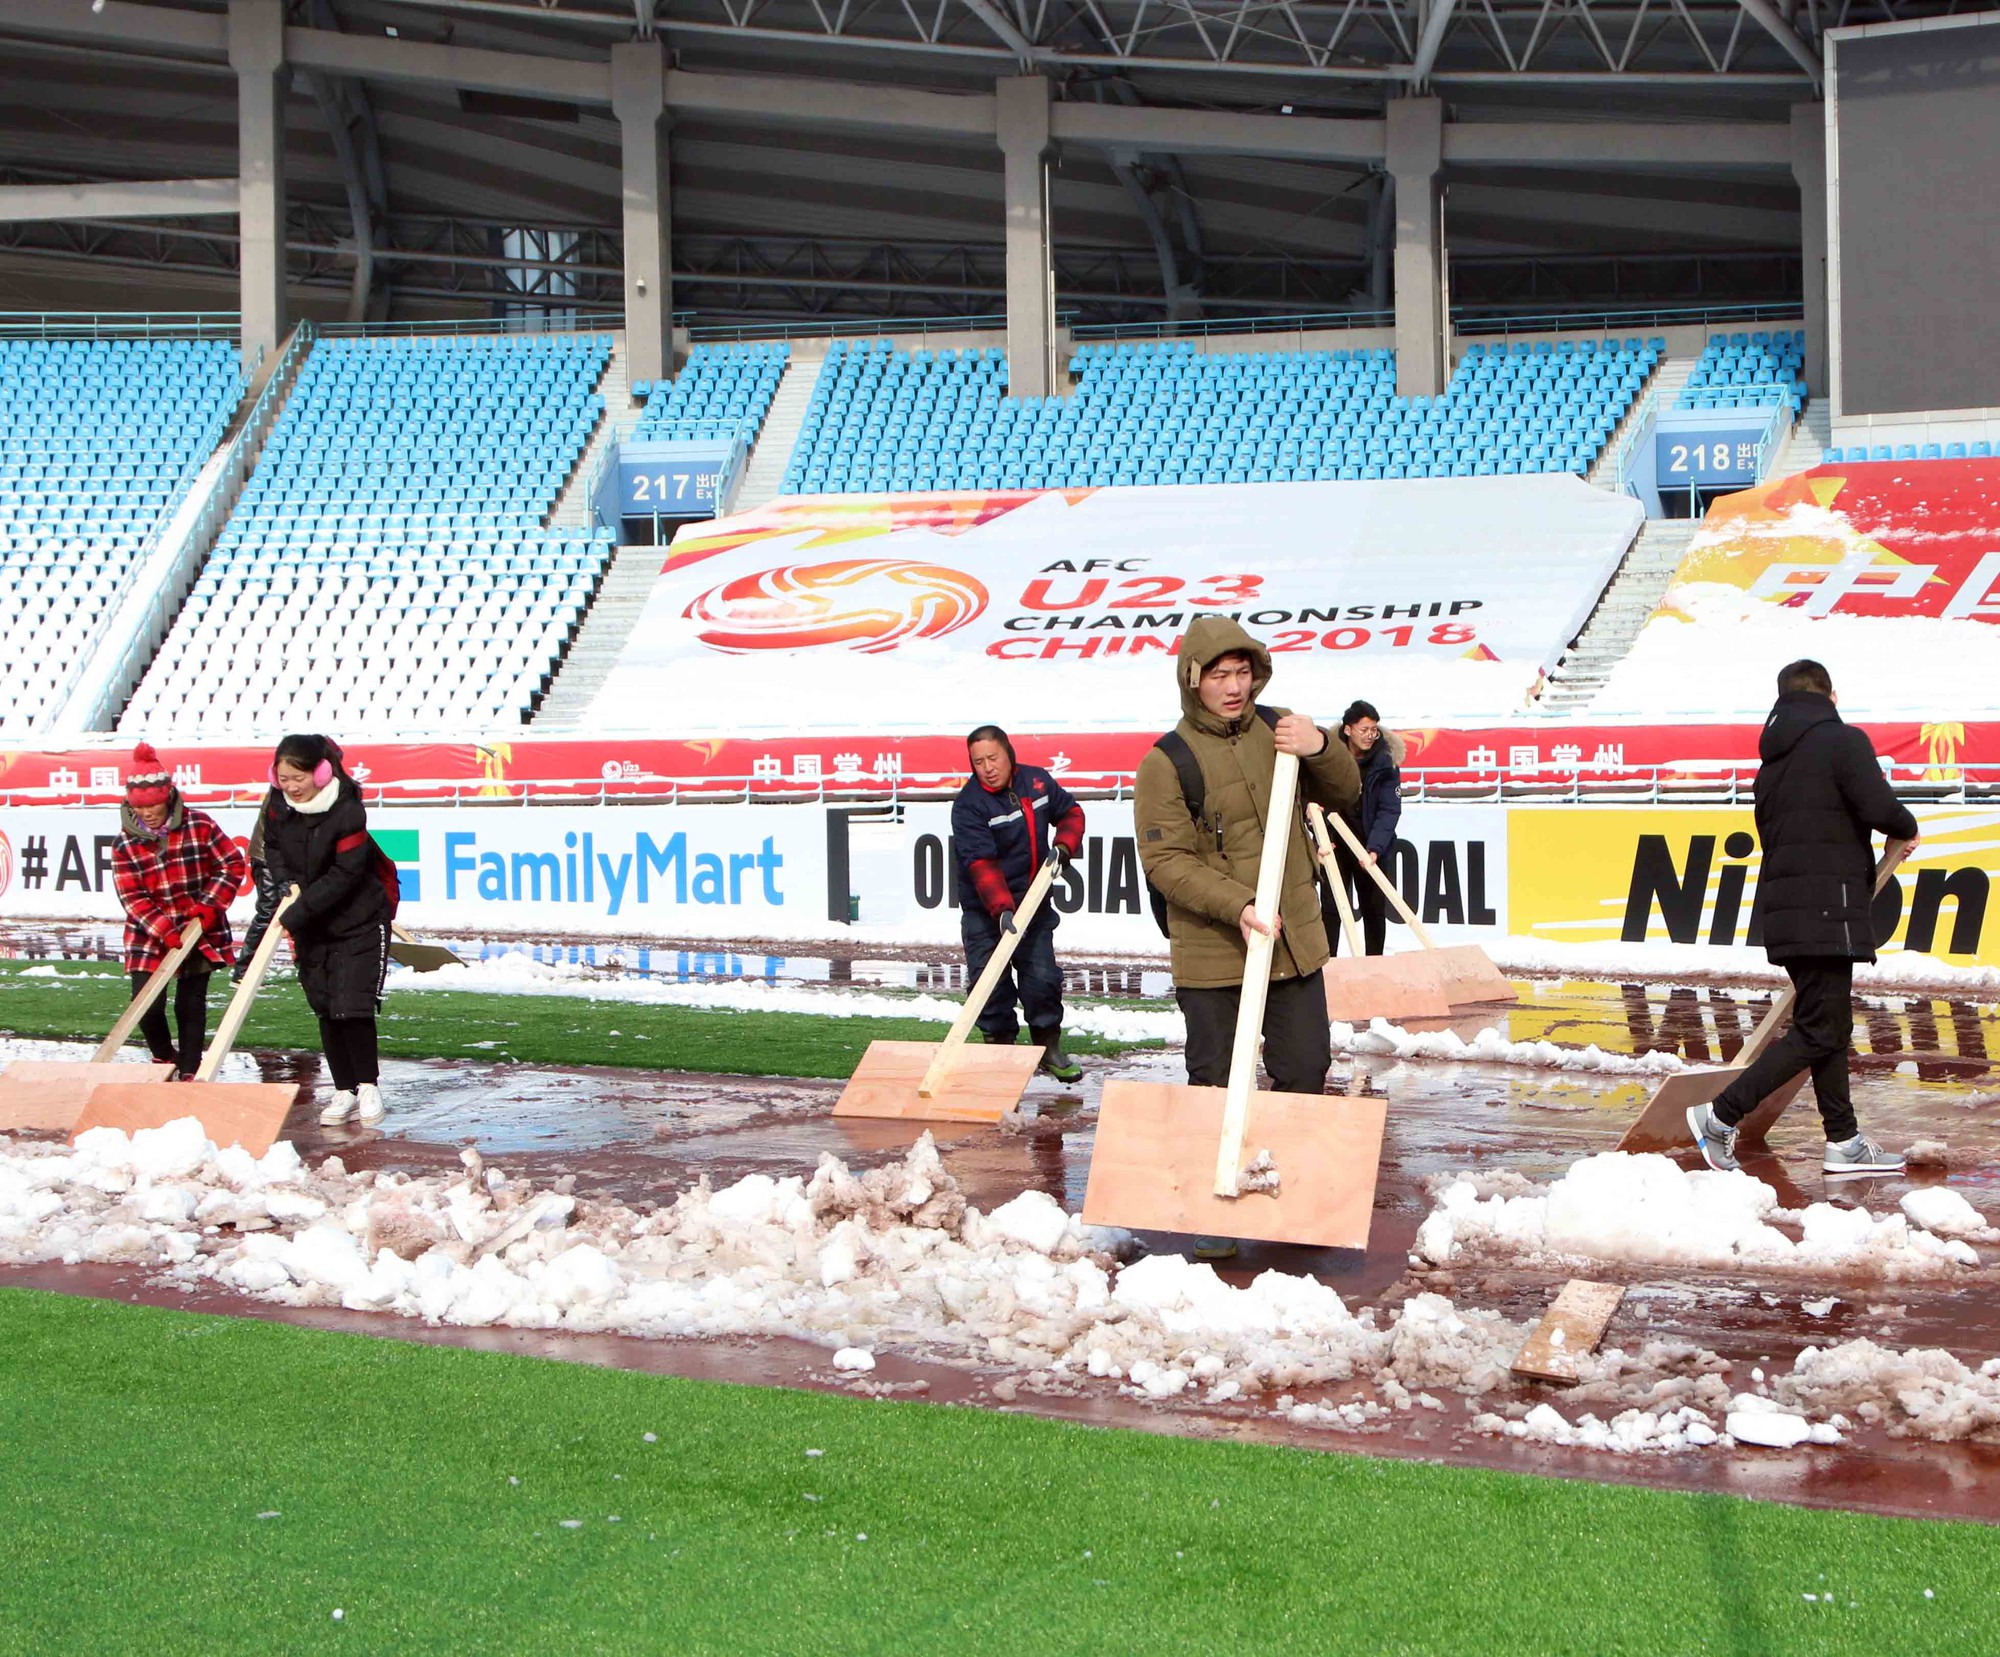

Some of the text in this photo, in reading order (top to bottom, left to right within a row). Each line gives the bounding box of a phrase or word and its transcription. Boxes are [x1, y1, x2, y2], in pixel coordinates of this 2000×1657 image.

[1669, 443, 1730, 472] 218
[1737, 459, 1755, 470] Ex
[632, 474, 690, 500] 217
[696, 489, 713, 499] Ex
[1039, 558, 1151, 573] AFC
[1019, 574, 1265, 611] U23
[1003, 600, 1483, 631] CHAMIONSHIP
[985, 622, 1477, 659] CHIN 2018
[753, 752, 902, 784] 中国常州
[1467, 743, 1625, 777] 中国常州
[49, 764, 201, 789] 中国州
[445, 831, 784, 916] FamilyMart
[1052, 836, 1142, 915] SIA
[1352, 838, 1496, 925] OAL
